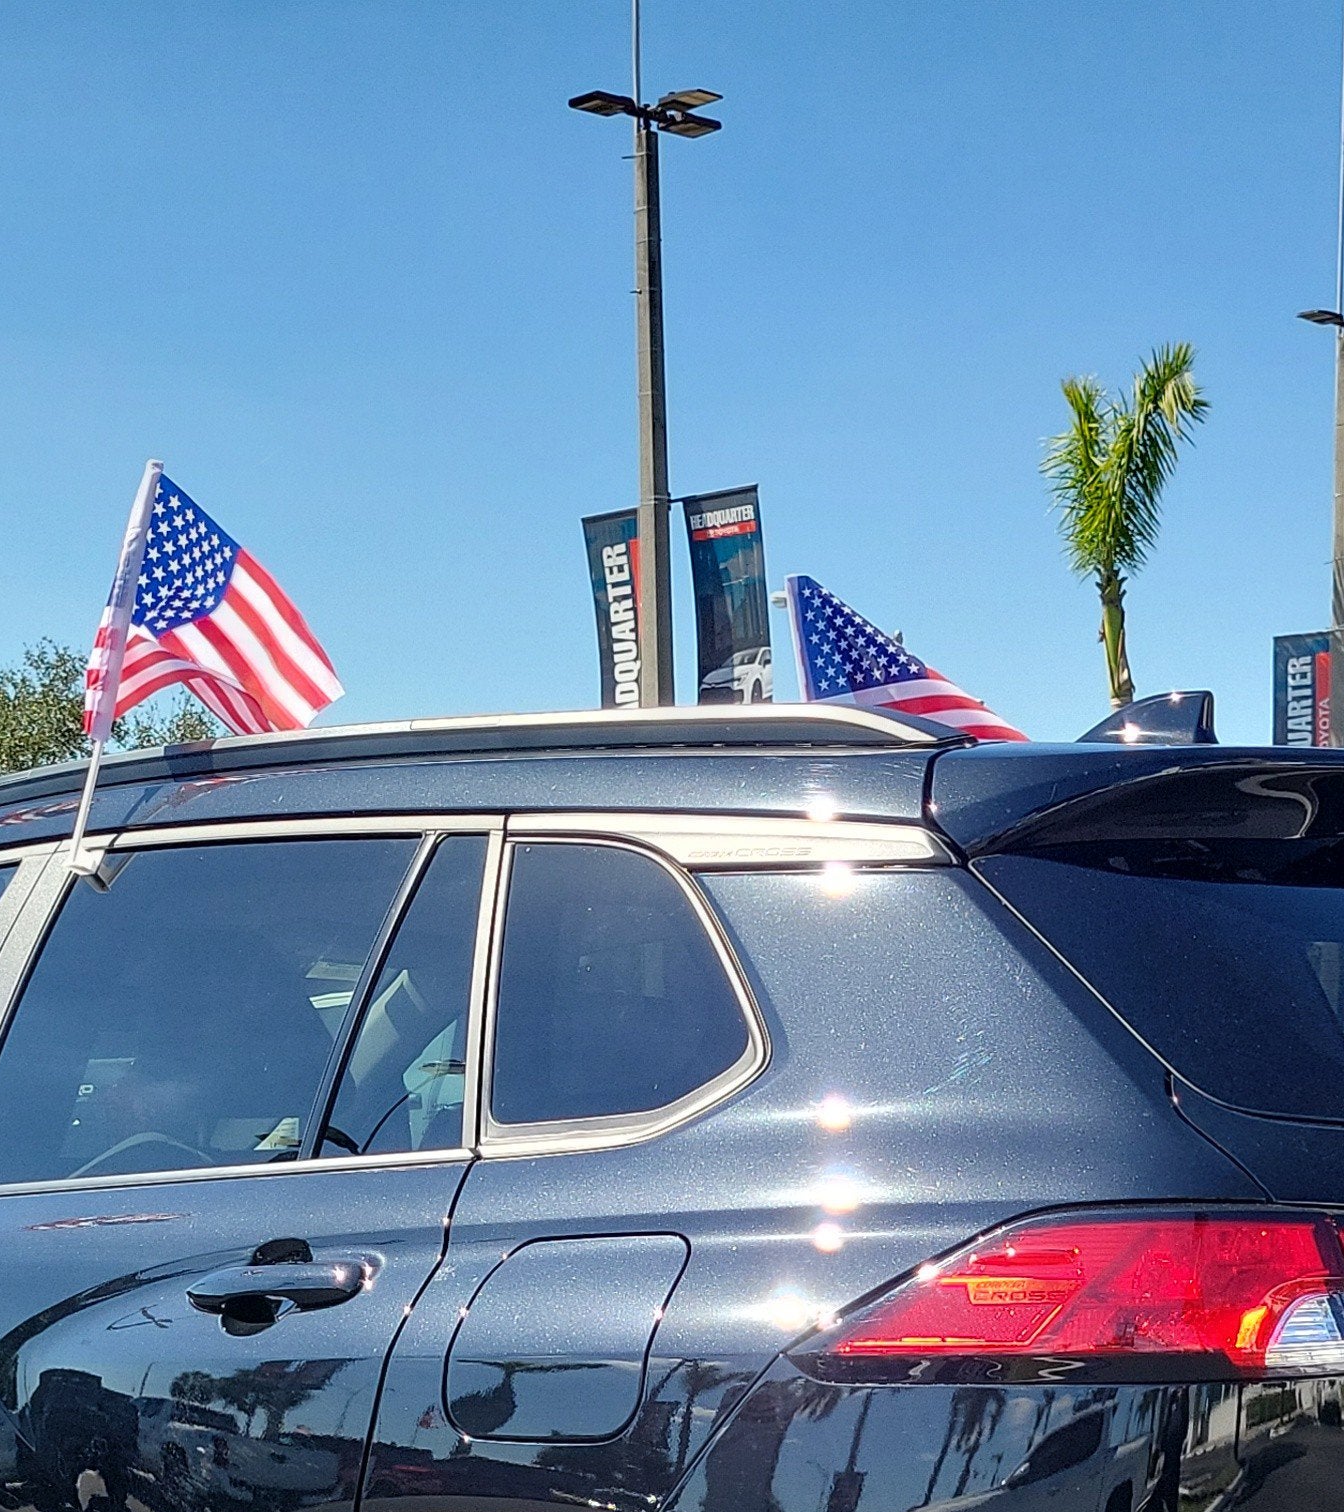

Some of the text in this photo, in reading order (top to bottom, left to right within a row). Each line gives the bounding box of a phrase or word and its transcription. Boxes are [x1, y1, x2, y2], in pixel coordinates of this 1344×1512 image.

[690, 504, 755, 531] HEADQUARTER
[602, 543, 641, 708] DQUARTER
[1287, 655, 1313, 747] UARTER
[1318, 698, 1329, 747] OYOTA
